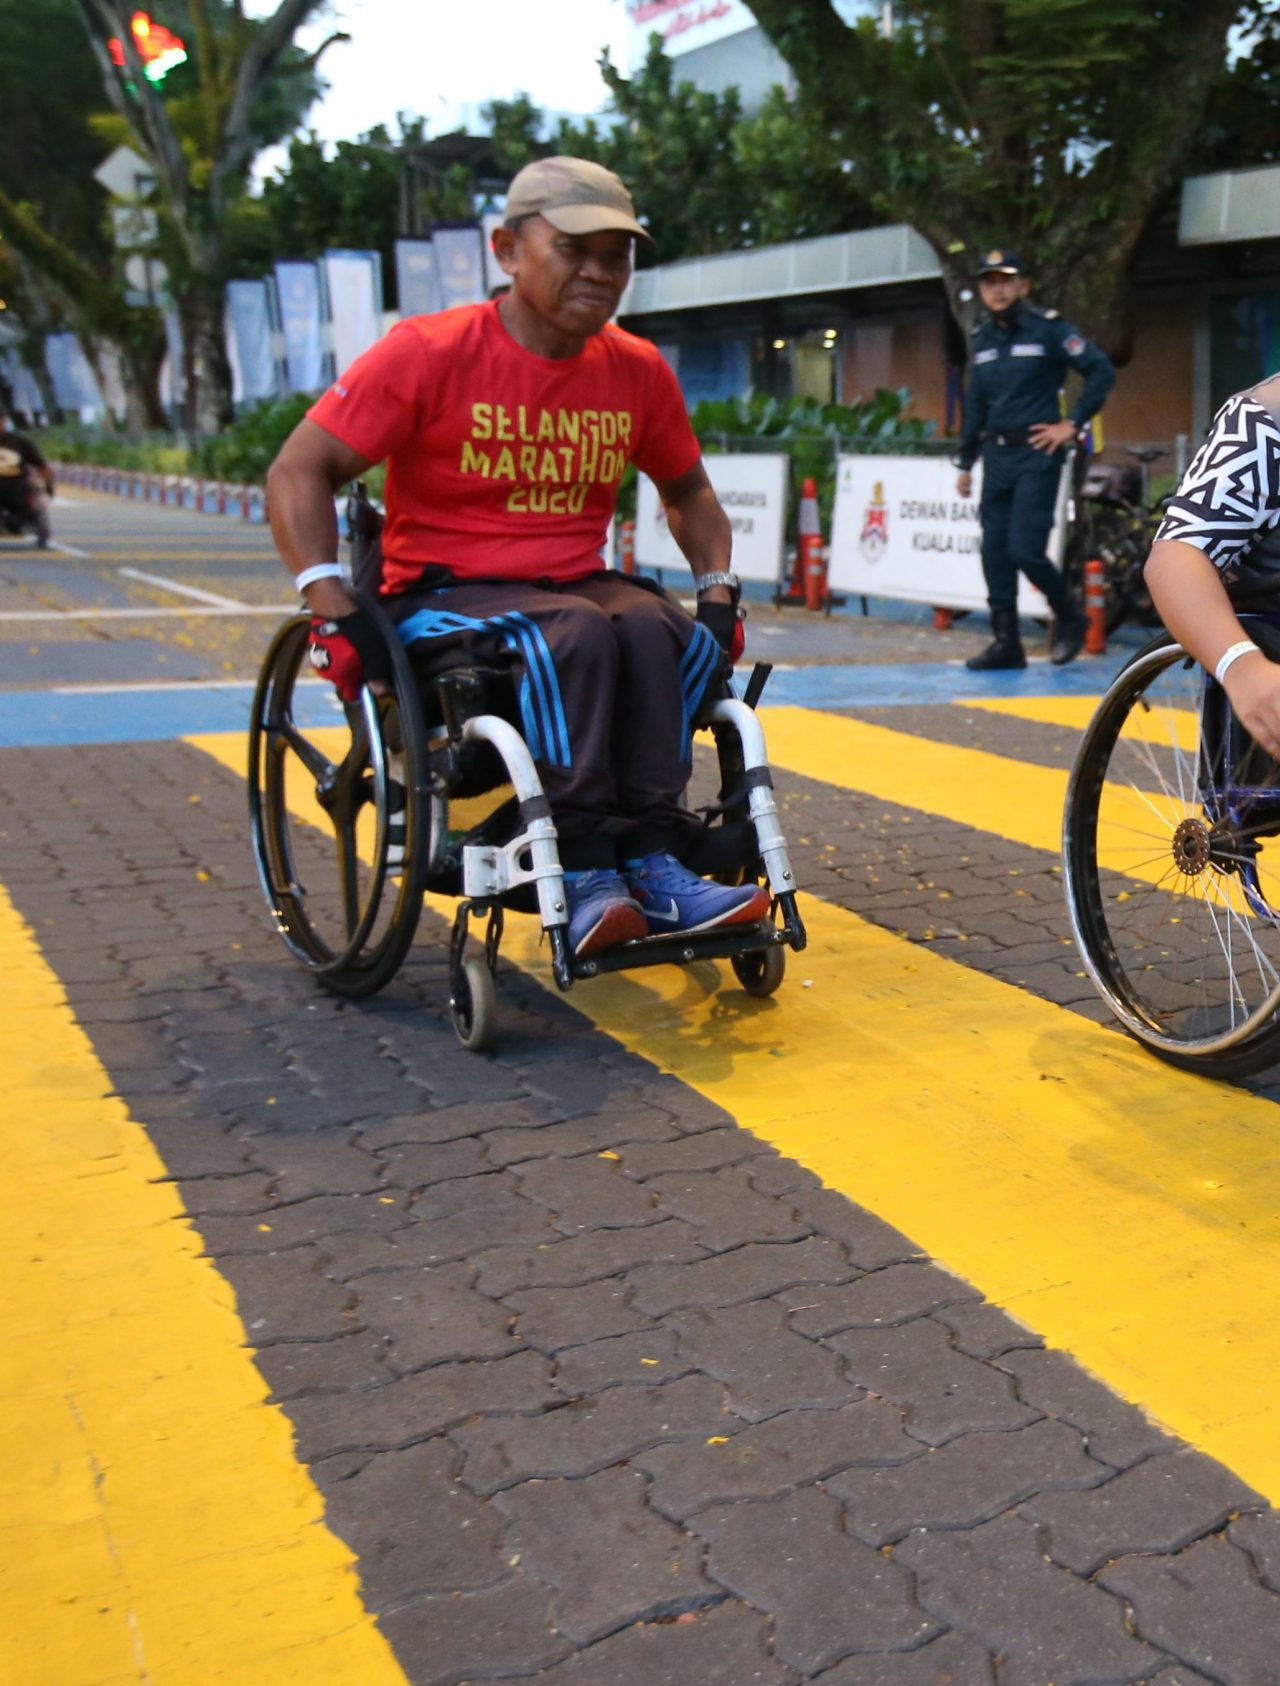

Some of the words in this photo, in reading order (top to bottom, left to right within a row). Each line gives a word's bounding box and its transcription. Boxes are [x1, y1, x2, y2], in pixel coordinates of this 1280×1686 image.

[471, 402, 632, 446] SELANGOR
[460, 434, 626, 484] MARATHON
[900, 500, 946, 520] DEWAN
[913, 532, 953, 553] KUALA
